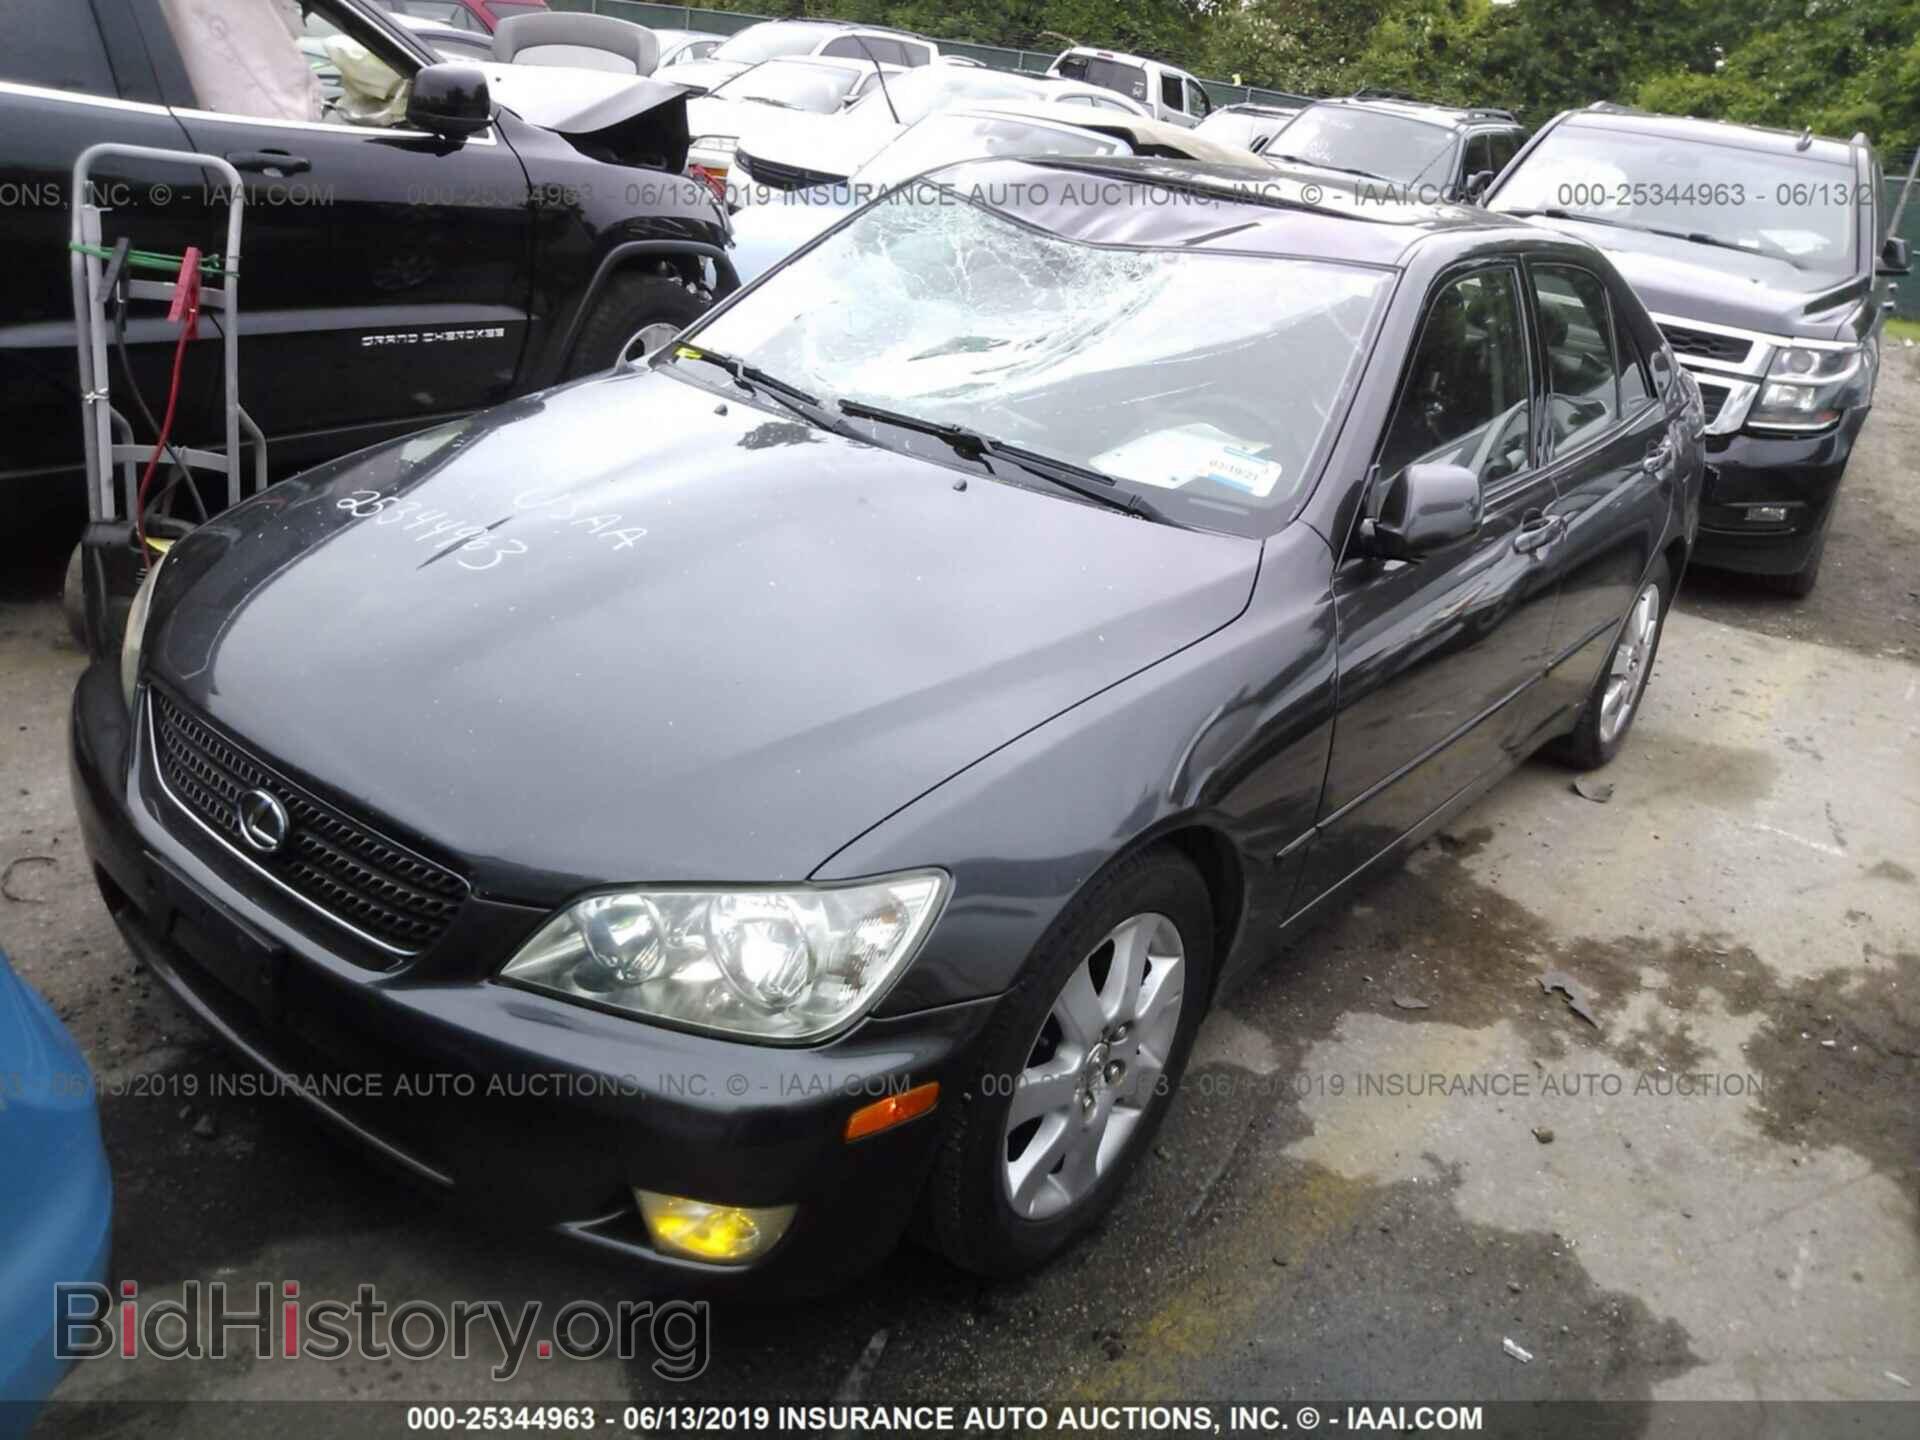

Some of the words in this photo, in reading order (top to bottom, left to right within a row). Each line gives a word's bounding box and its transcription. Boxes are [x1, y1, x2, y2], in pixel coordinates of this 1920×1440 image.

[361, 333, 419, 347] GRAND
[422, 327, 505, 343] CHEROKEE
[512, 487, 648, 551] USAA
